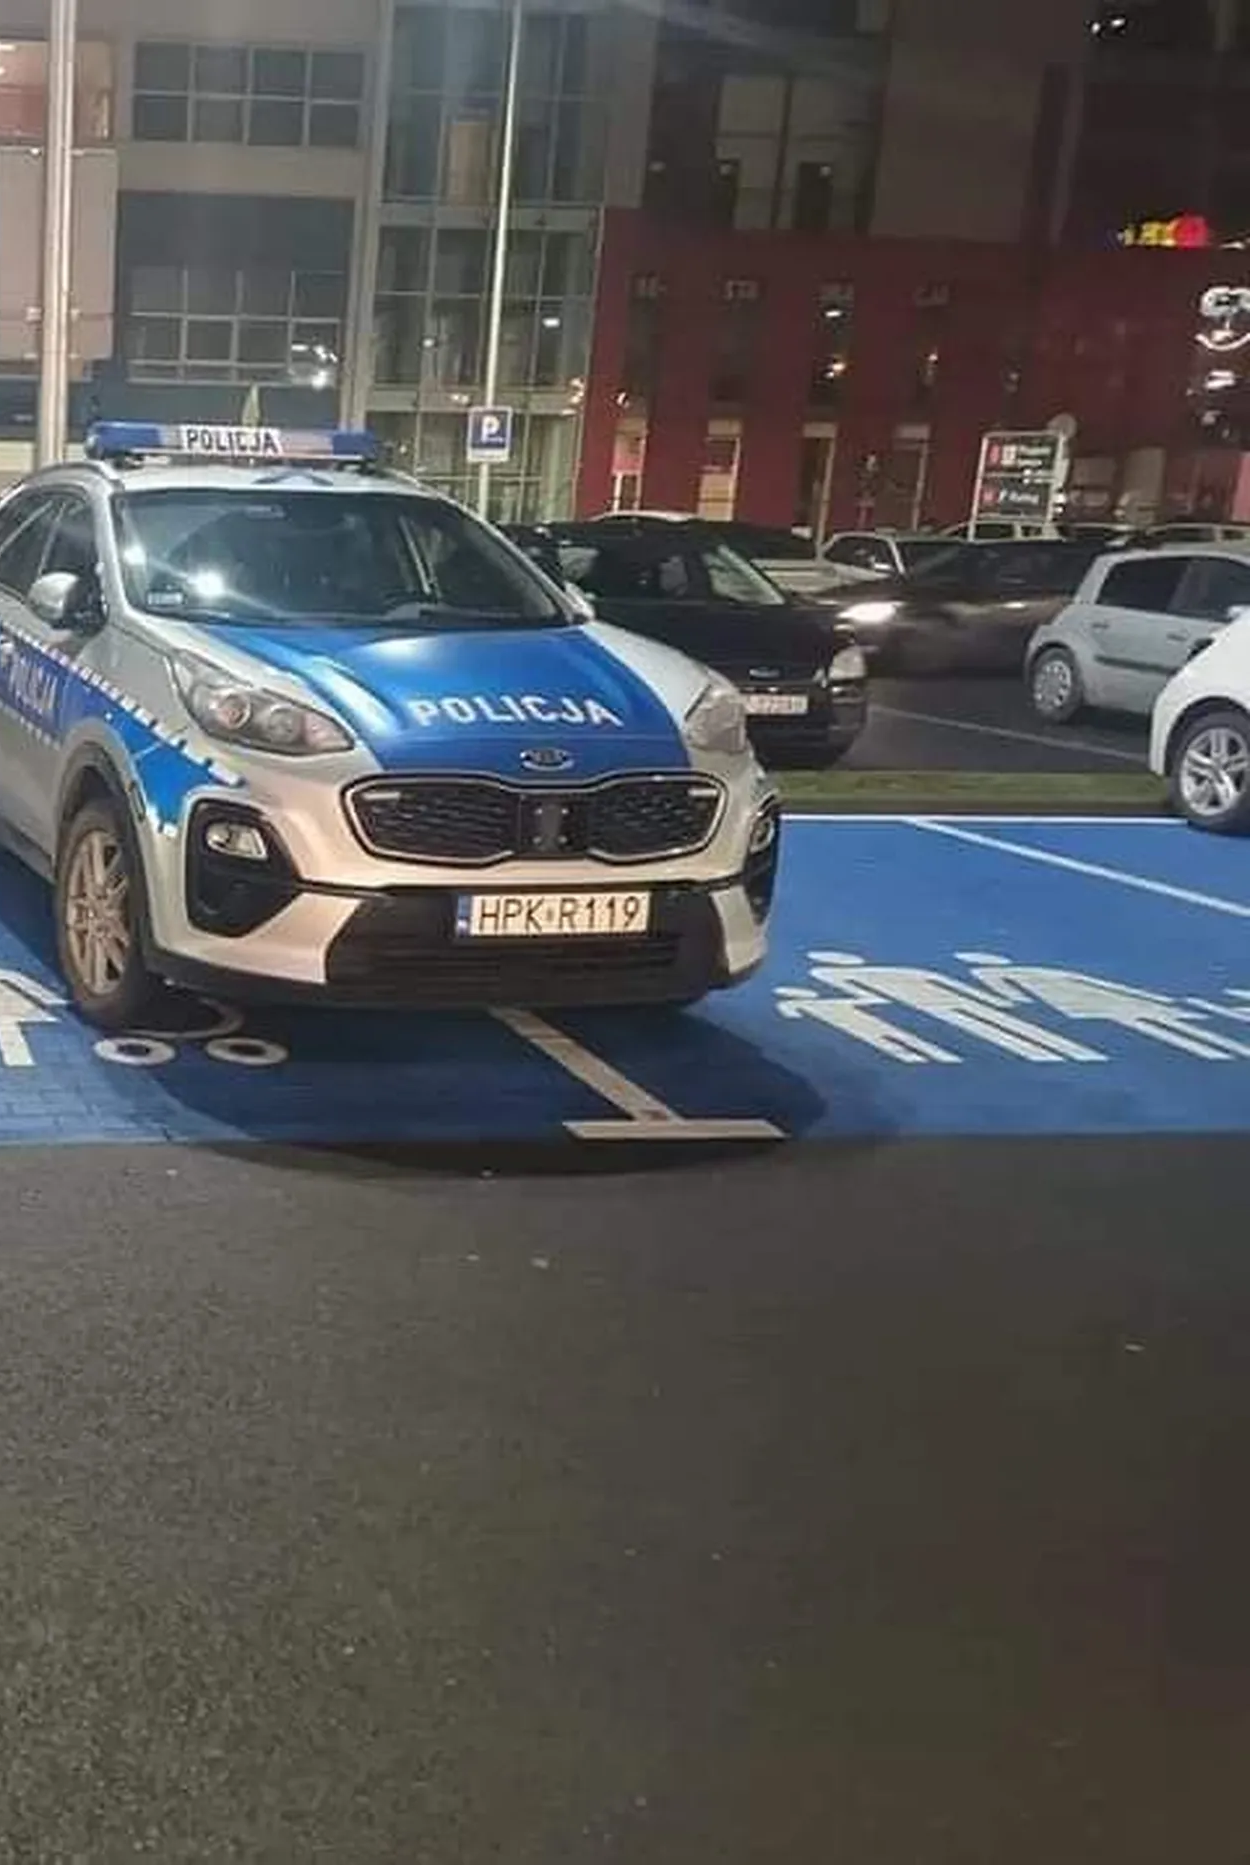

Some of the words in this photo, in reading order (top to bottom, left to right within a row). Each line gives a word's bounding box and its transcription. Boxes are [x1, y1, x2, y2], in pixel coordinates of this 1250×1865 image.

[186, 428, 280, 455] POLICJA
[481, 415, 500, 443] P
[407, 695, 625, 728] POLICJA
[478, 898, 545, 933] HPK
[558, 895, 641, 930] R119
